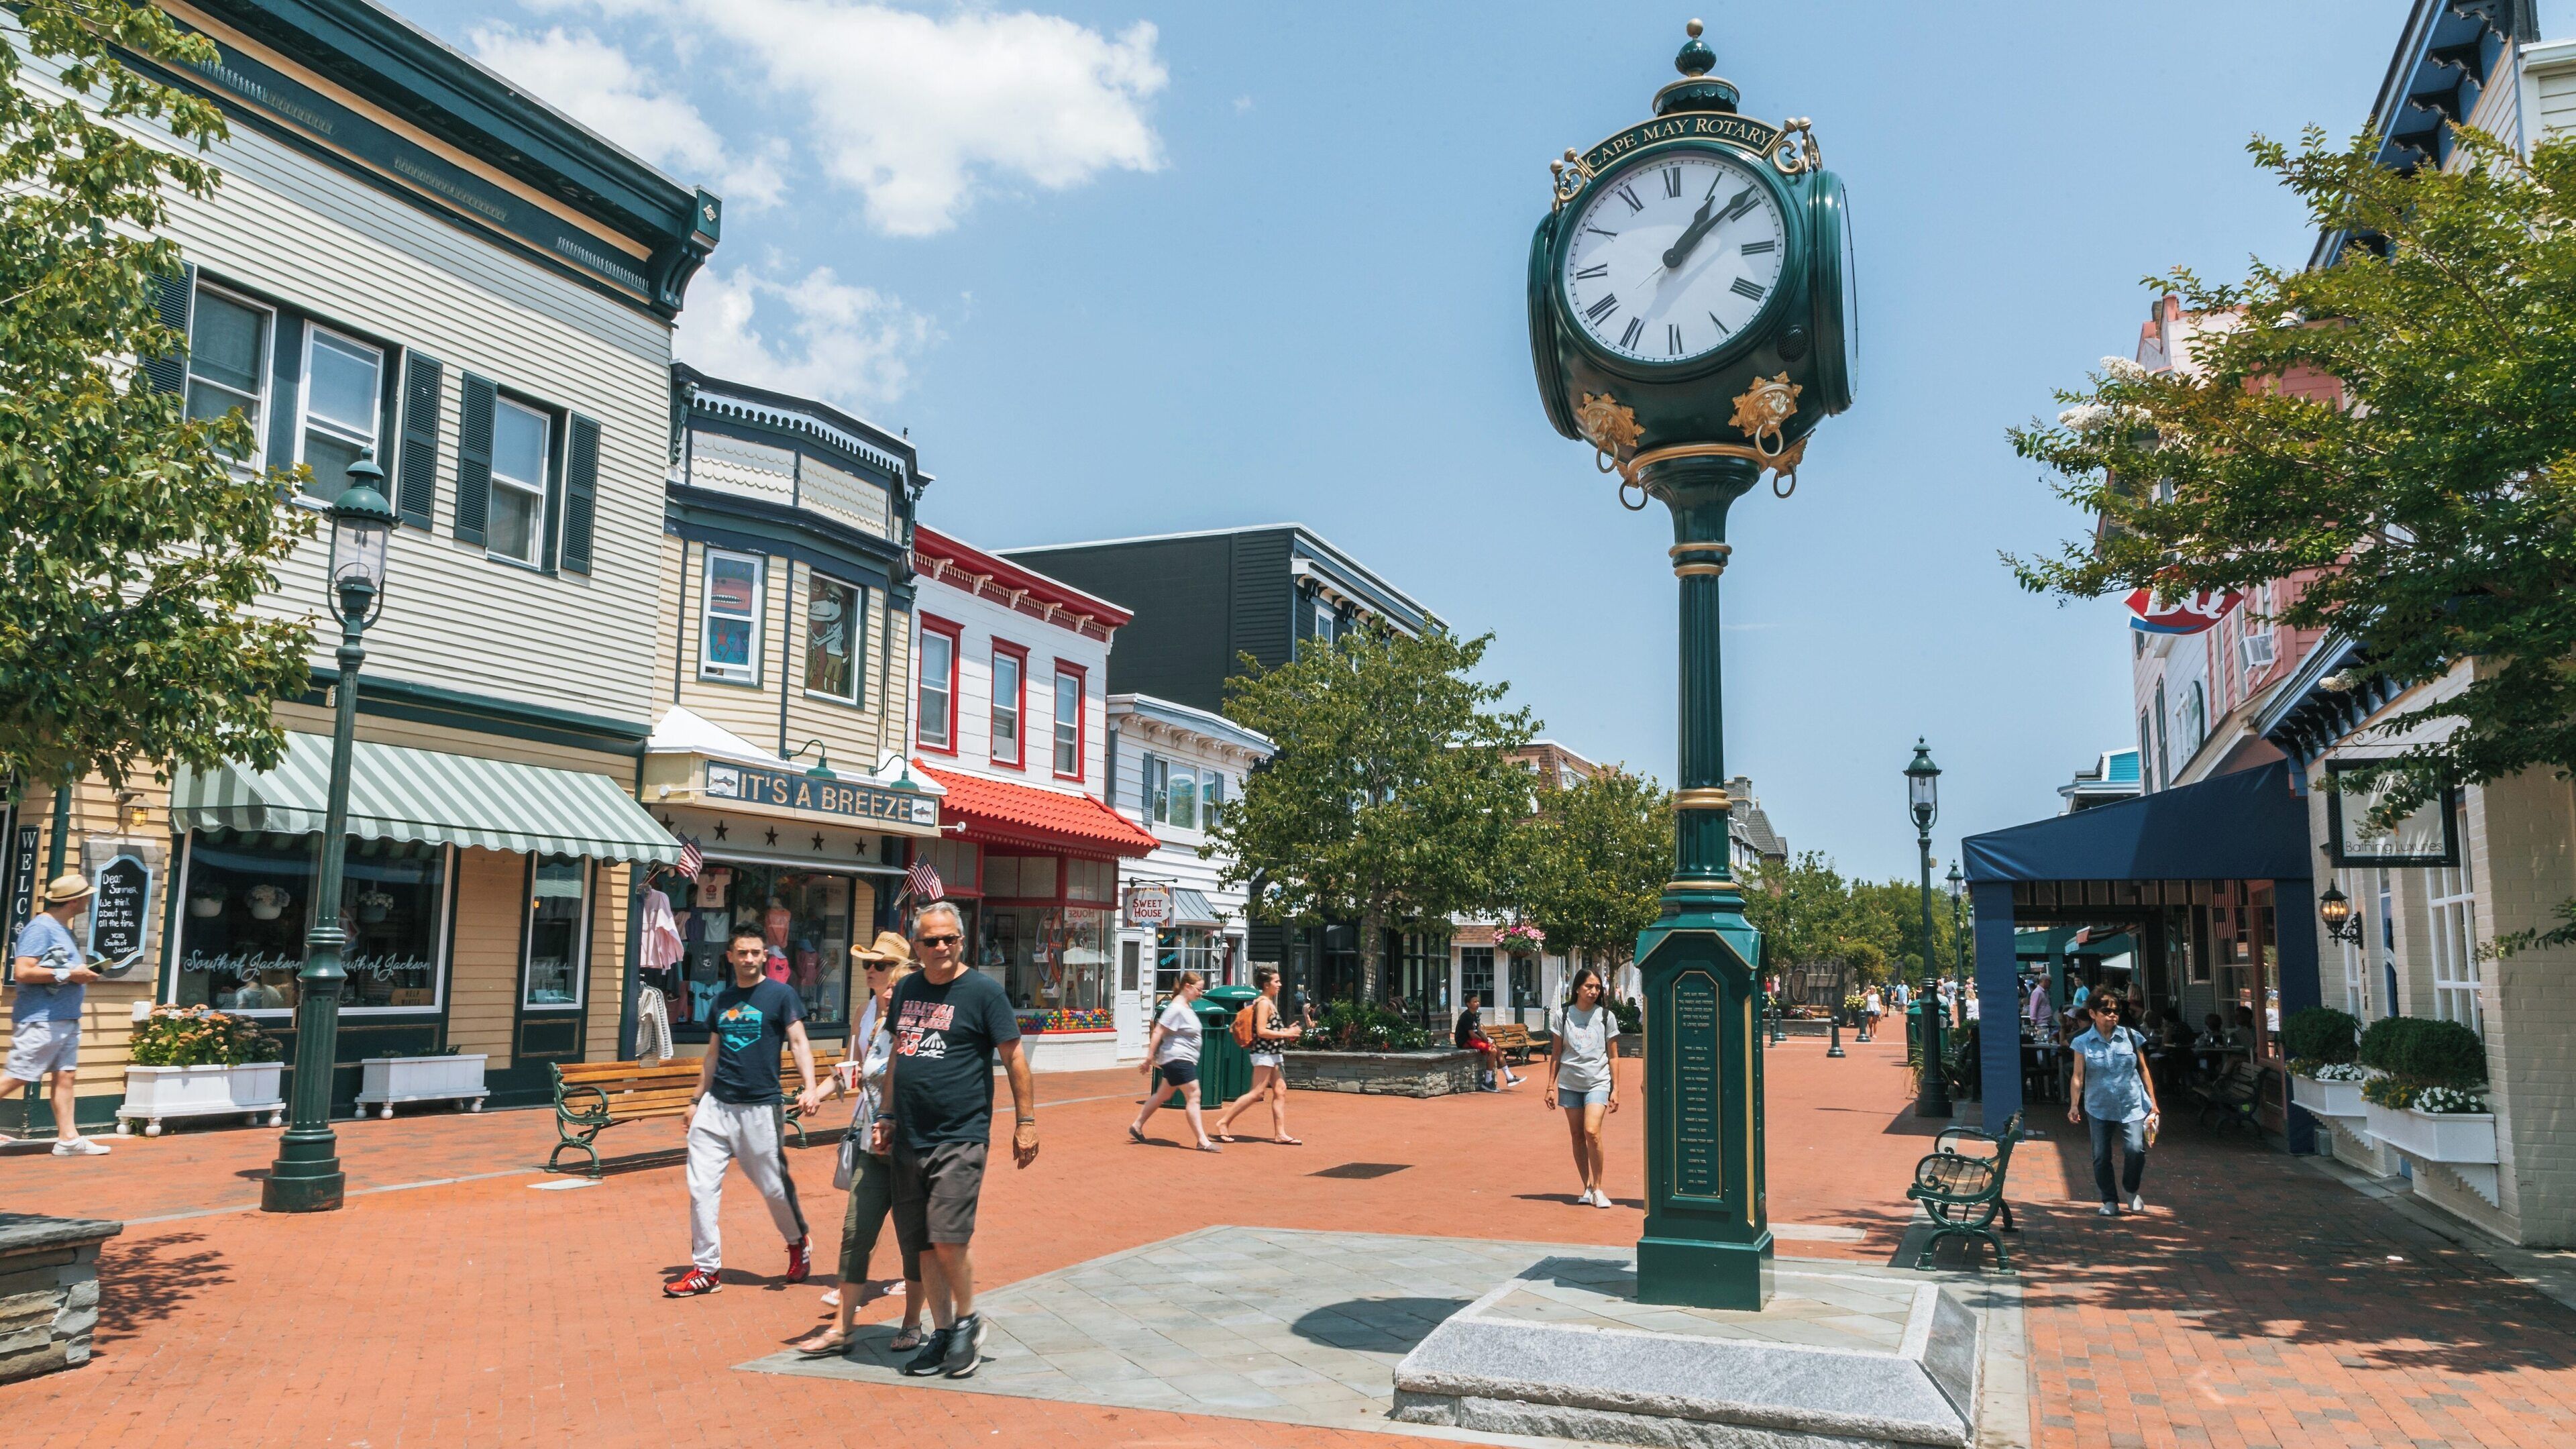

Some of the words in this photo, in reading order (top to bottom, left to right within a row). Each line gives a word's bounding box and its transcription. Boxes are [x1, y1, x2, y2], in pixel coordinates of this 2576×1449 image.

[1586, 134, 1638, 168] CAPE
[1642, 118, 1690, 142] MAY
[1695, 118, 1775, 147] ROTARY
[2144, 584, 2222, 619] DQ
[740, 773, 788, 804] IT'S
[796, 782, 812, 808] A
[821, 786, 911, 821] BREEZE
[2345, 841, 2393, 854] Bathing
[2396, 840, 2443, 853] Luxuries
[103, 873, 123, 885] Dear
[9, 831, 38, 982] WELC
[99, 899, 111, 907] We
[114, 898, 130, 906] think
[1132, 898, 1163, 908] SWEET
[98, 908, 118, 917] about
[121, 910, 133, 919] you
[1134, 908, 1163, 917] HOUSE
[109, 919, 119, 927] the
[104, 938, 120, 947] South
[113, 946, 138, 954] Jackson
[184, 949, 229, 973] South
[229, 953, 245, 980] of
[241, 951, 304, 982] Jackson
[341, 955, 367, 972] outh
[368, 955, 381, 979] of
[377, 953, 431, 982] Jackson
[901, 1000, 955, 1020] SARATOGA
